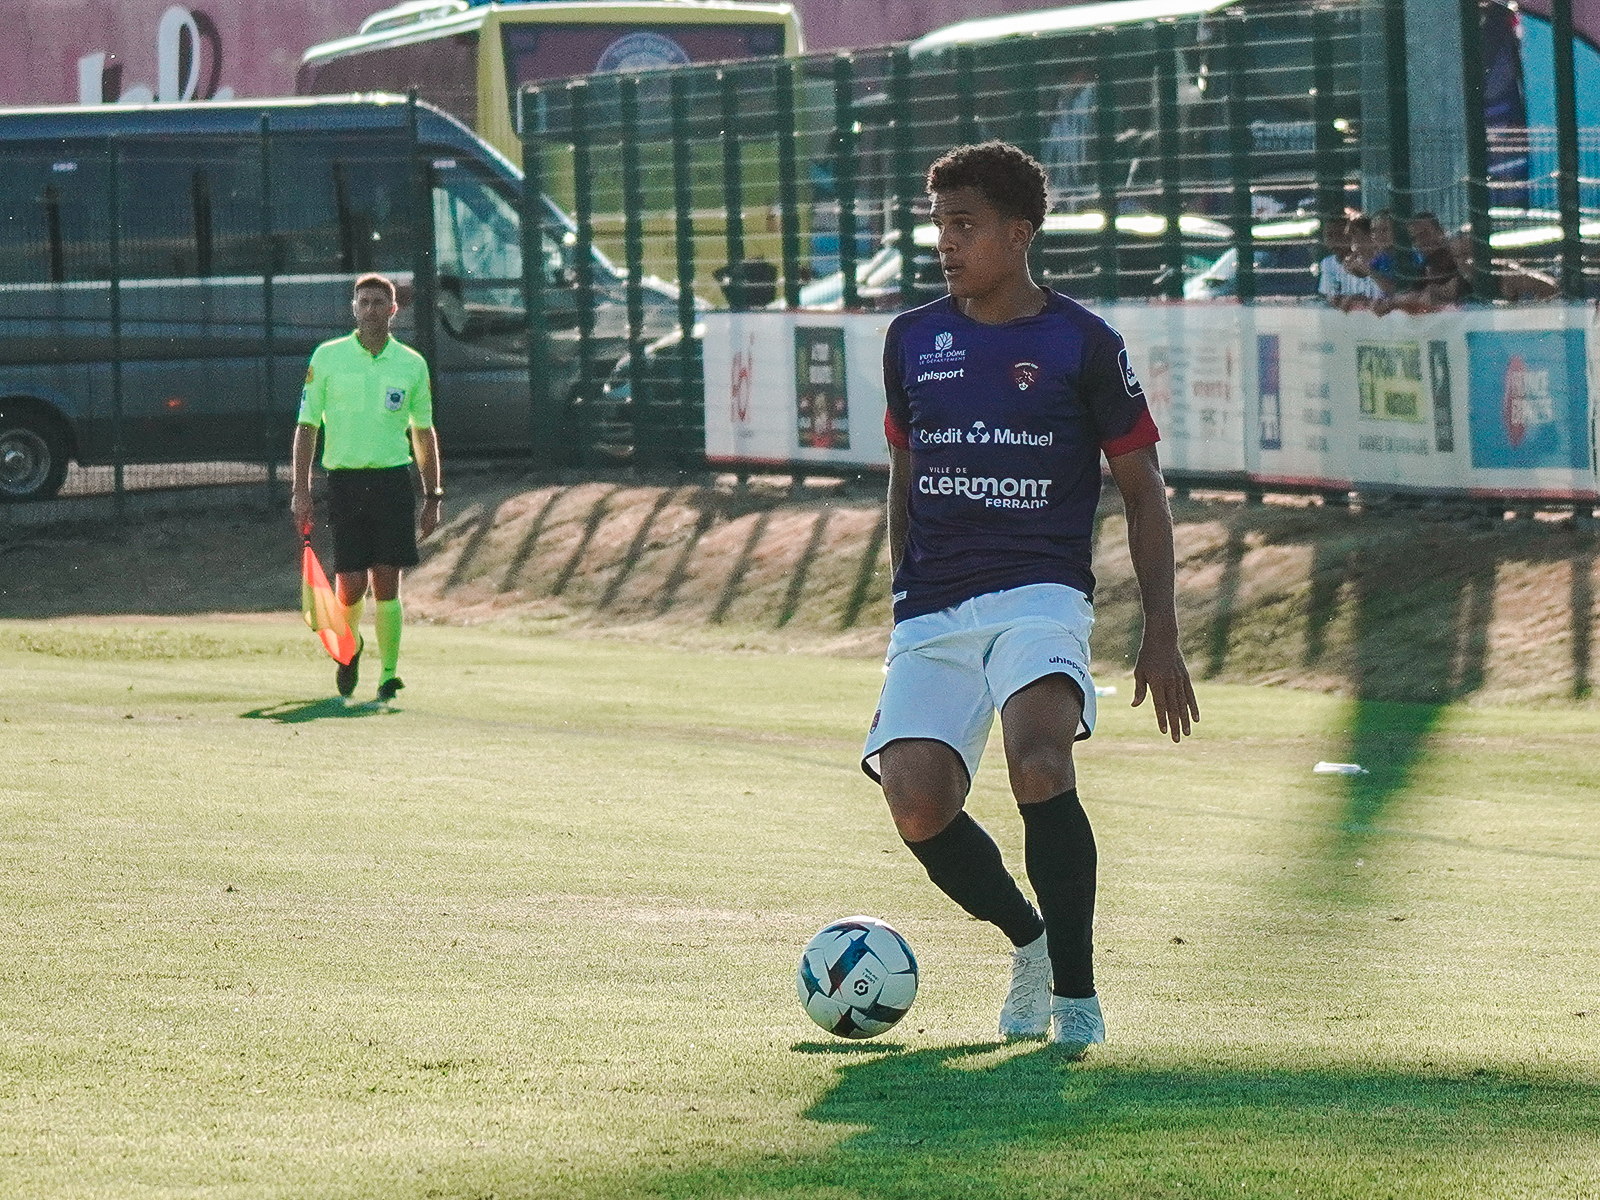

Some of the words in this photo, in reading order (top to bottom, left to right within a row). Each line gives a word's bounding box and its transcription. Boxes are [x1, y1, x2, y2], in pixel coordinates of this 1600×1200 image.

[917, 368, 964, 382] uhlsport
[919, 428, 962, 444] Crédit
[994, 428, 1053, 446] Mutuel
[929, 466, 950, 474] VILLE
